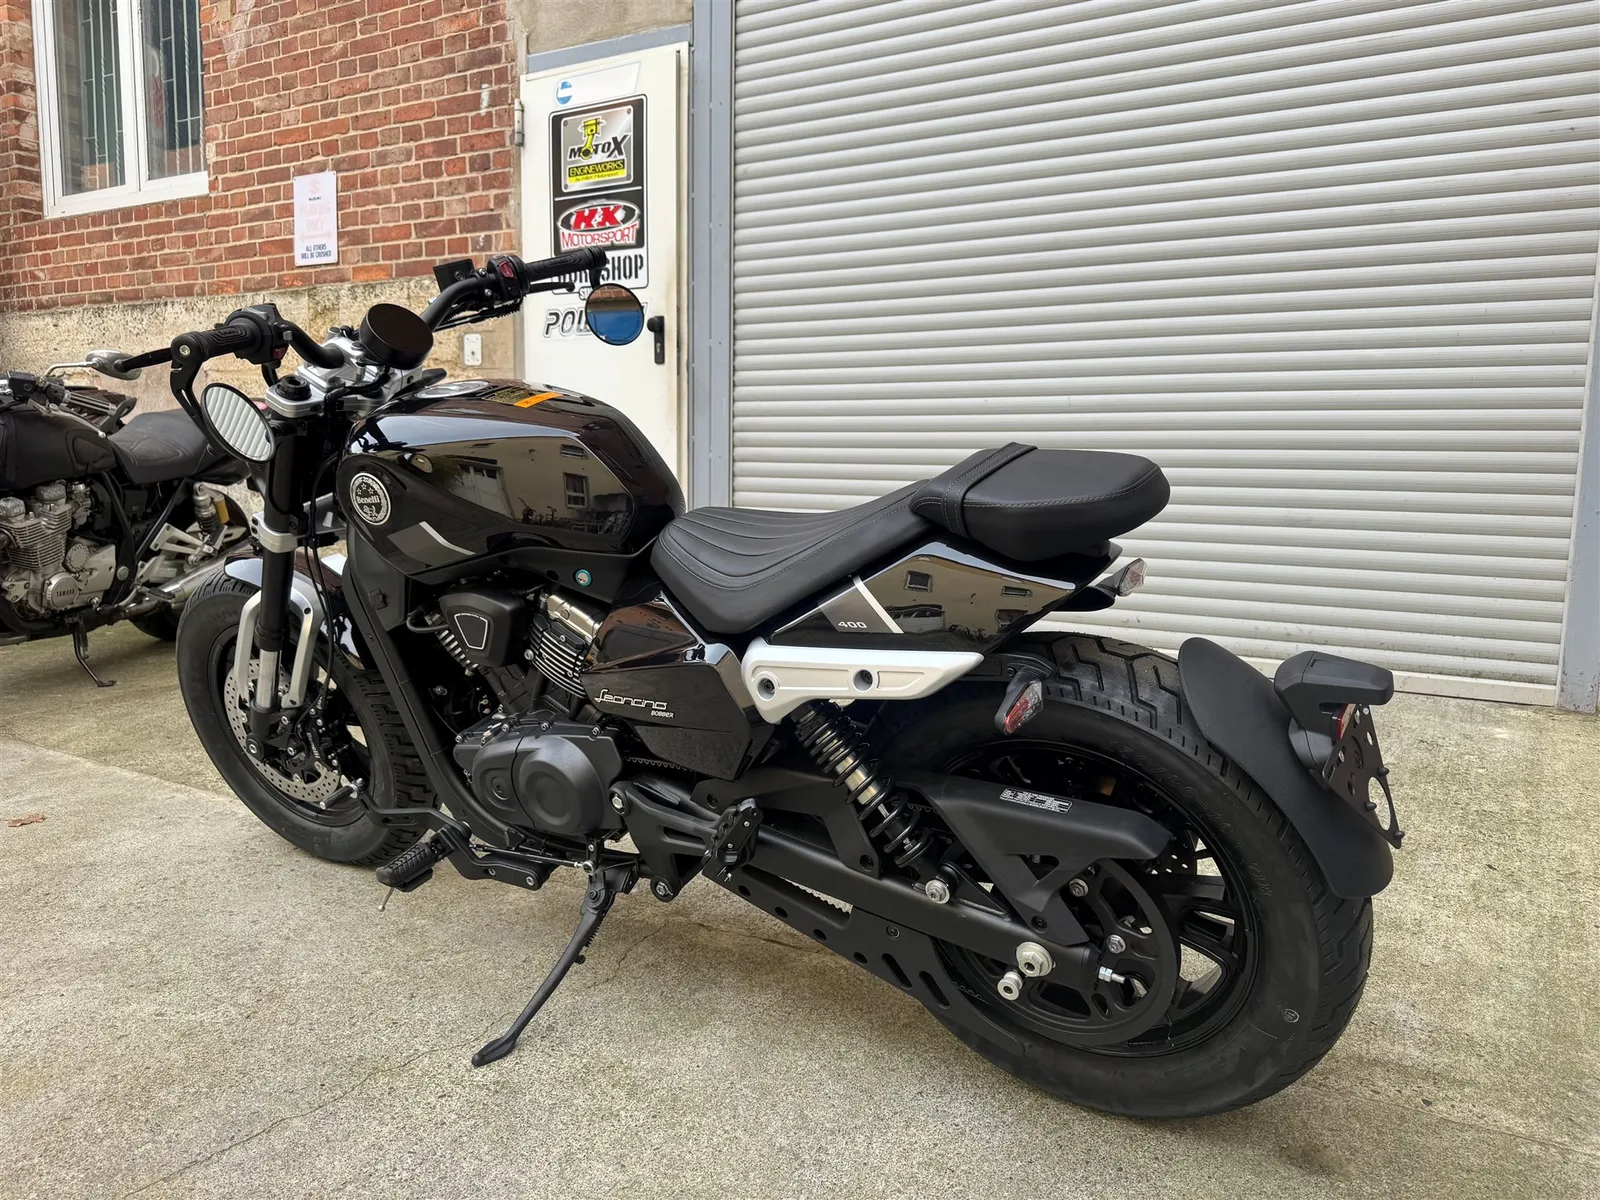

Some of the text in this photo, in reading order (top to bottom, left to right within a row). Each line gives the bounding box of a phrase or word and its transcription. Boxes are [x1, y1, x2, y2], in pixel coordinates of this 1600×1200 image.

[561, 223, 639, 249] MOTORSPORT
[356, 494, 380, 504] Benelli
[837, 621, 868, 629] 400
[651, 710, 674, 718] BOBBER
